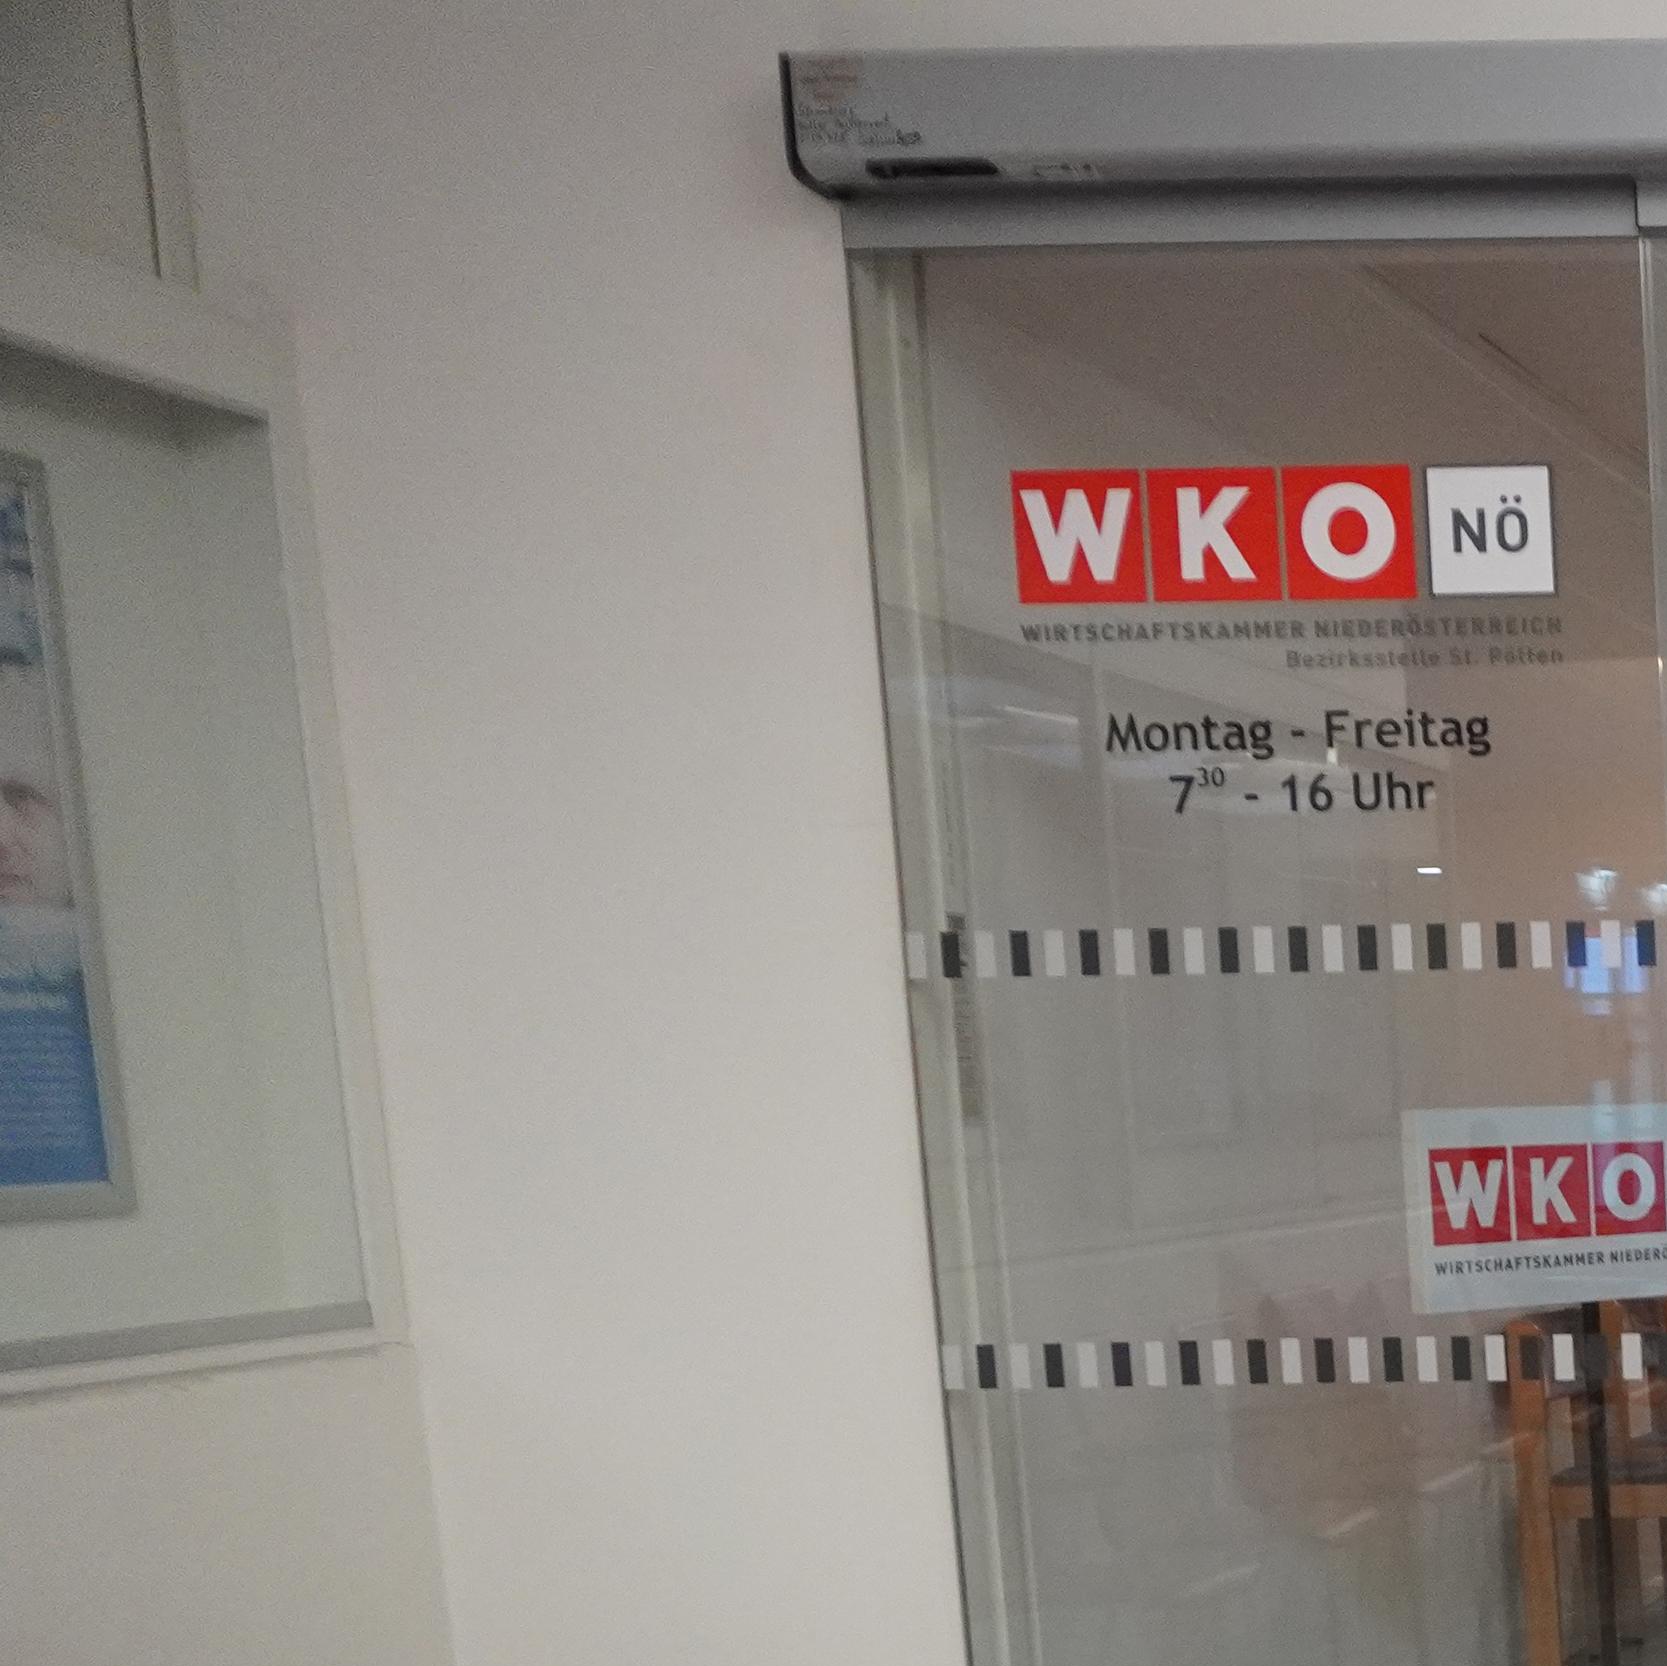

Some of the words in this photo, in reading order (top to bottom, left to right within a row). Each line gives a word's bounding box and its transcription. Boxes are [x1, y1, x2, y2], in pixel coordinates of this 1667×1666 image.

[1019, 482, 1397, 584] WKO
[1449, 494, 1530, 554] NÖ
[1020, 620, 1305, 643] WIRTSCHAFTSKAMMER
[1314, 614, 1563, 639] NIEDERÖSTERREICH
[1106, 710, 1274, 760] Montag
[1325, 708, 1492, 757] Freitag
[1281, 773, 1333, 812] 16
[1353, 773, 1434, 811] Uhr
[1434, 1152, 1656, 1229] WKO
[1435, 1251, 1605, 1276] WIRTSCHAFTSKAMMER
